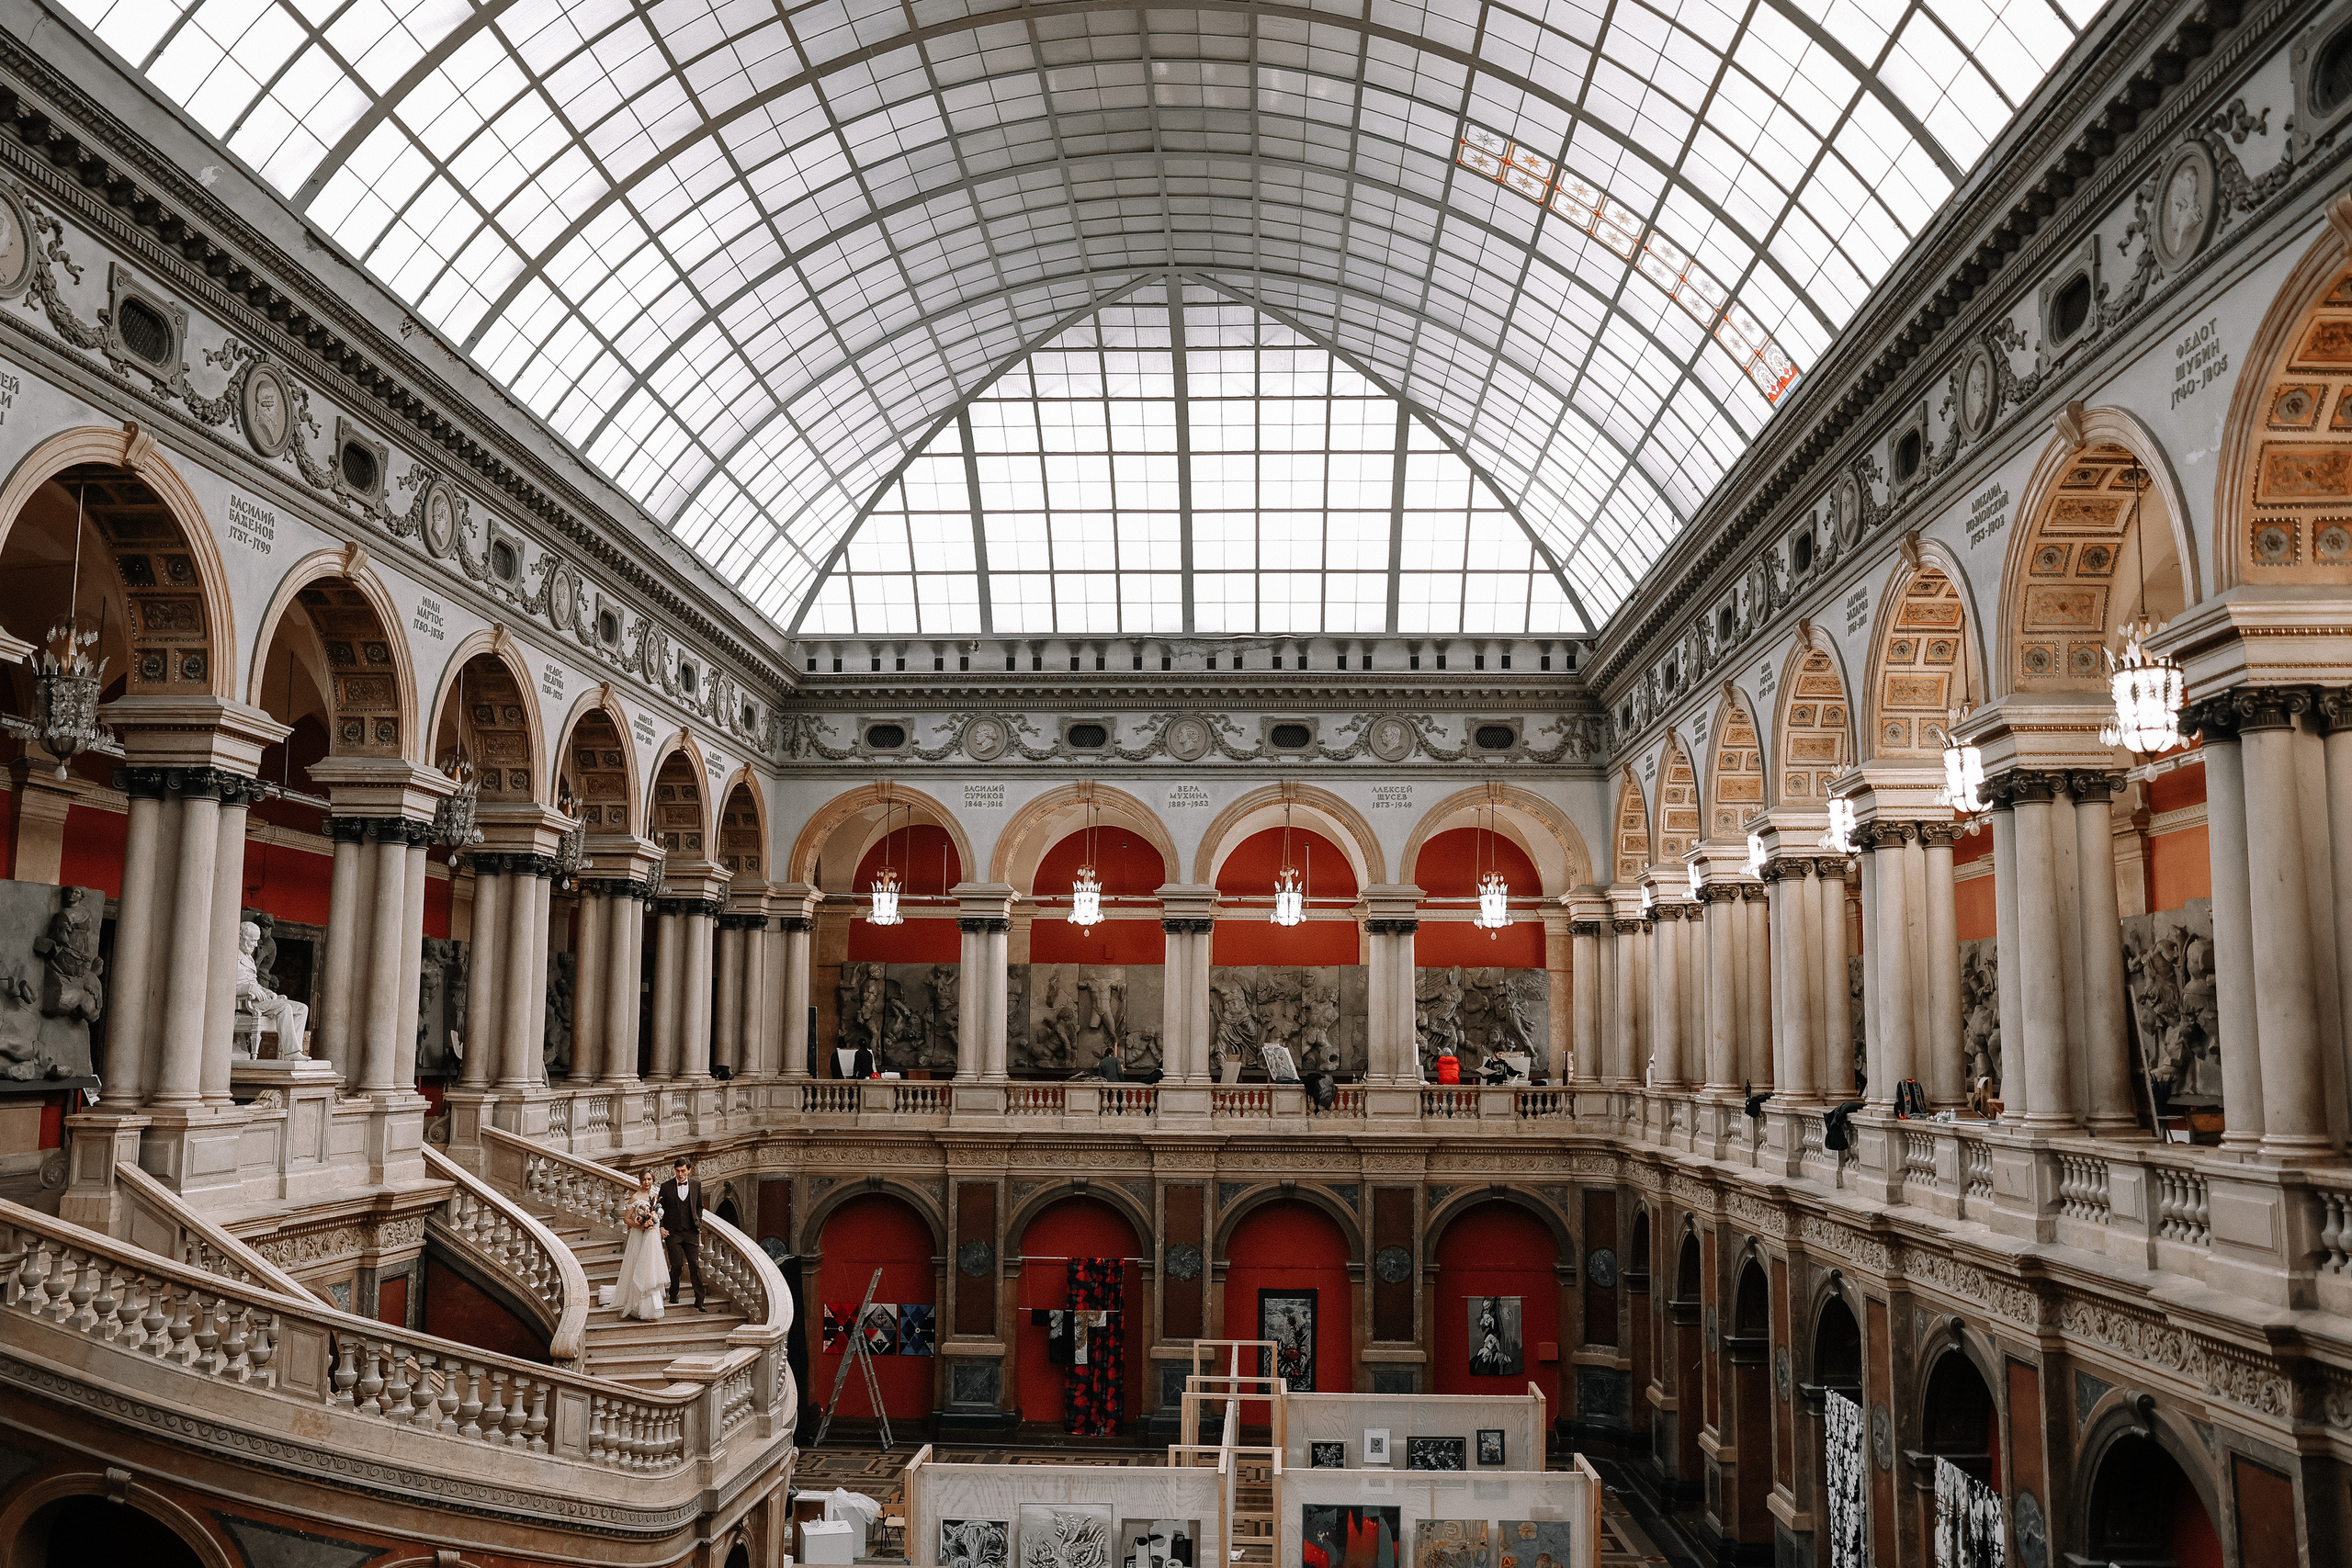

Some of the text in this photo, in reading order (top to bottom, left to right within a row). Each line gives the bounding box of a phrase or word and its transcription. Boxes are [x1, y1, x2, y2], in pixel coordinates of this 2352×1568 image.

[2176, 317, 2217, 359] ФЕДОТ
[2176, 337, 2220, 382] ШУБИН
[2171, 354, 2228, 411] 1740-1805
[230, 493, 276, 527] ВАСИЛИЙ
[1971, 481, 2002, 514] МИХАИЛ
[229, 507, 275, 541] БАЖЕНОВ
[1965, 490, 2009, 534] КОЗЛОВСКИЙ
[228, 525, 272, 555] 1737-1799
[416, 604, 444, 627] МАРТОС
[422, 595, 441, 614] ИВАН
[964, 784, 1005, 793] ВАСИЛИЙ
[1177, 784, 1200, 793] ВЕРА
[1371, 784, 1413, 794] АЛЕКСЕЙ
[964, 800, 1003, 808] 1848-1916
[1168, 800, 1209, 809] 1889-1953
[1371, 801, 1413, 809] 1873-1949
